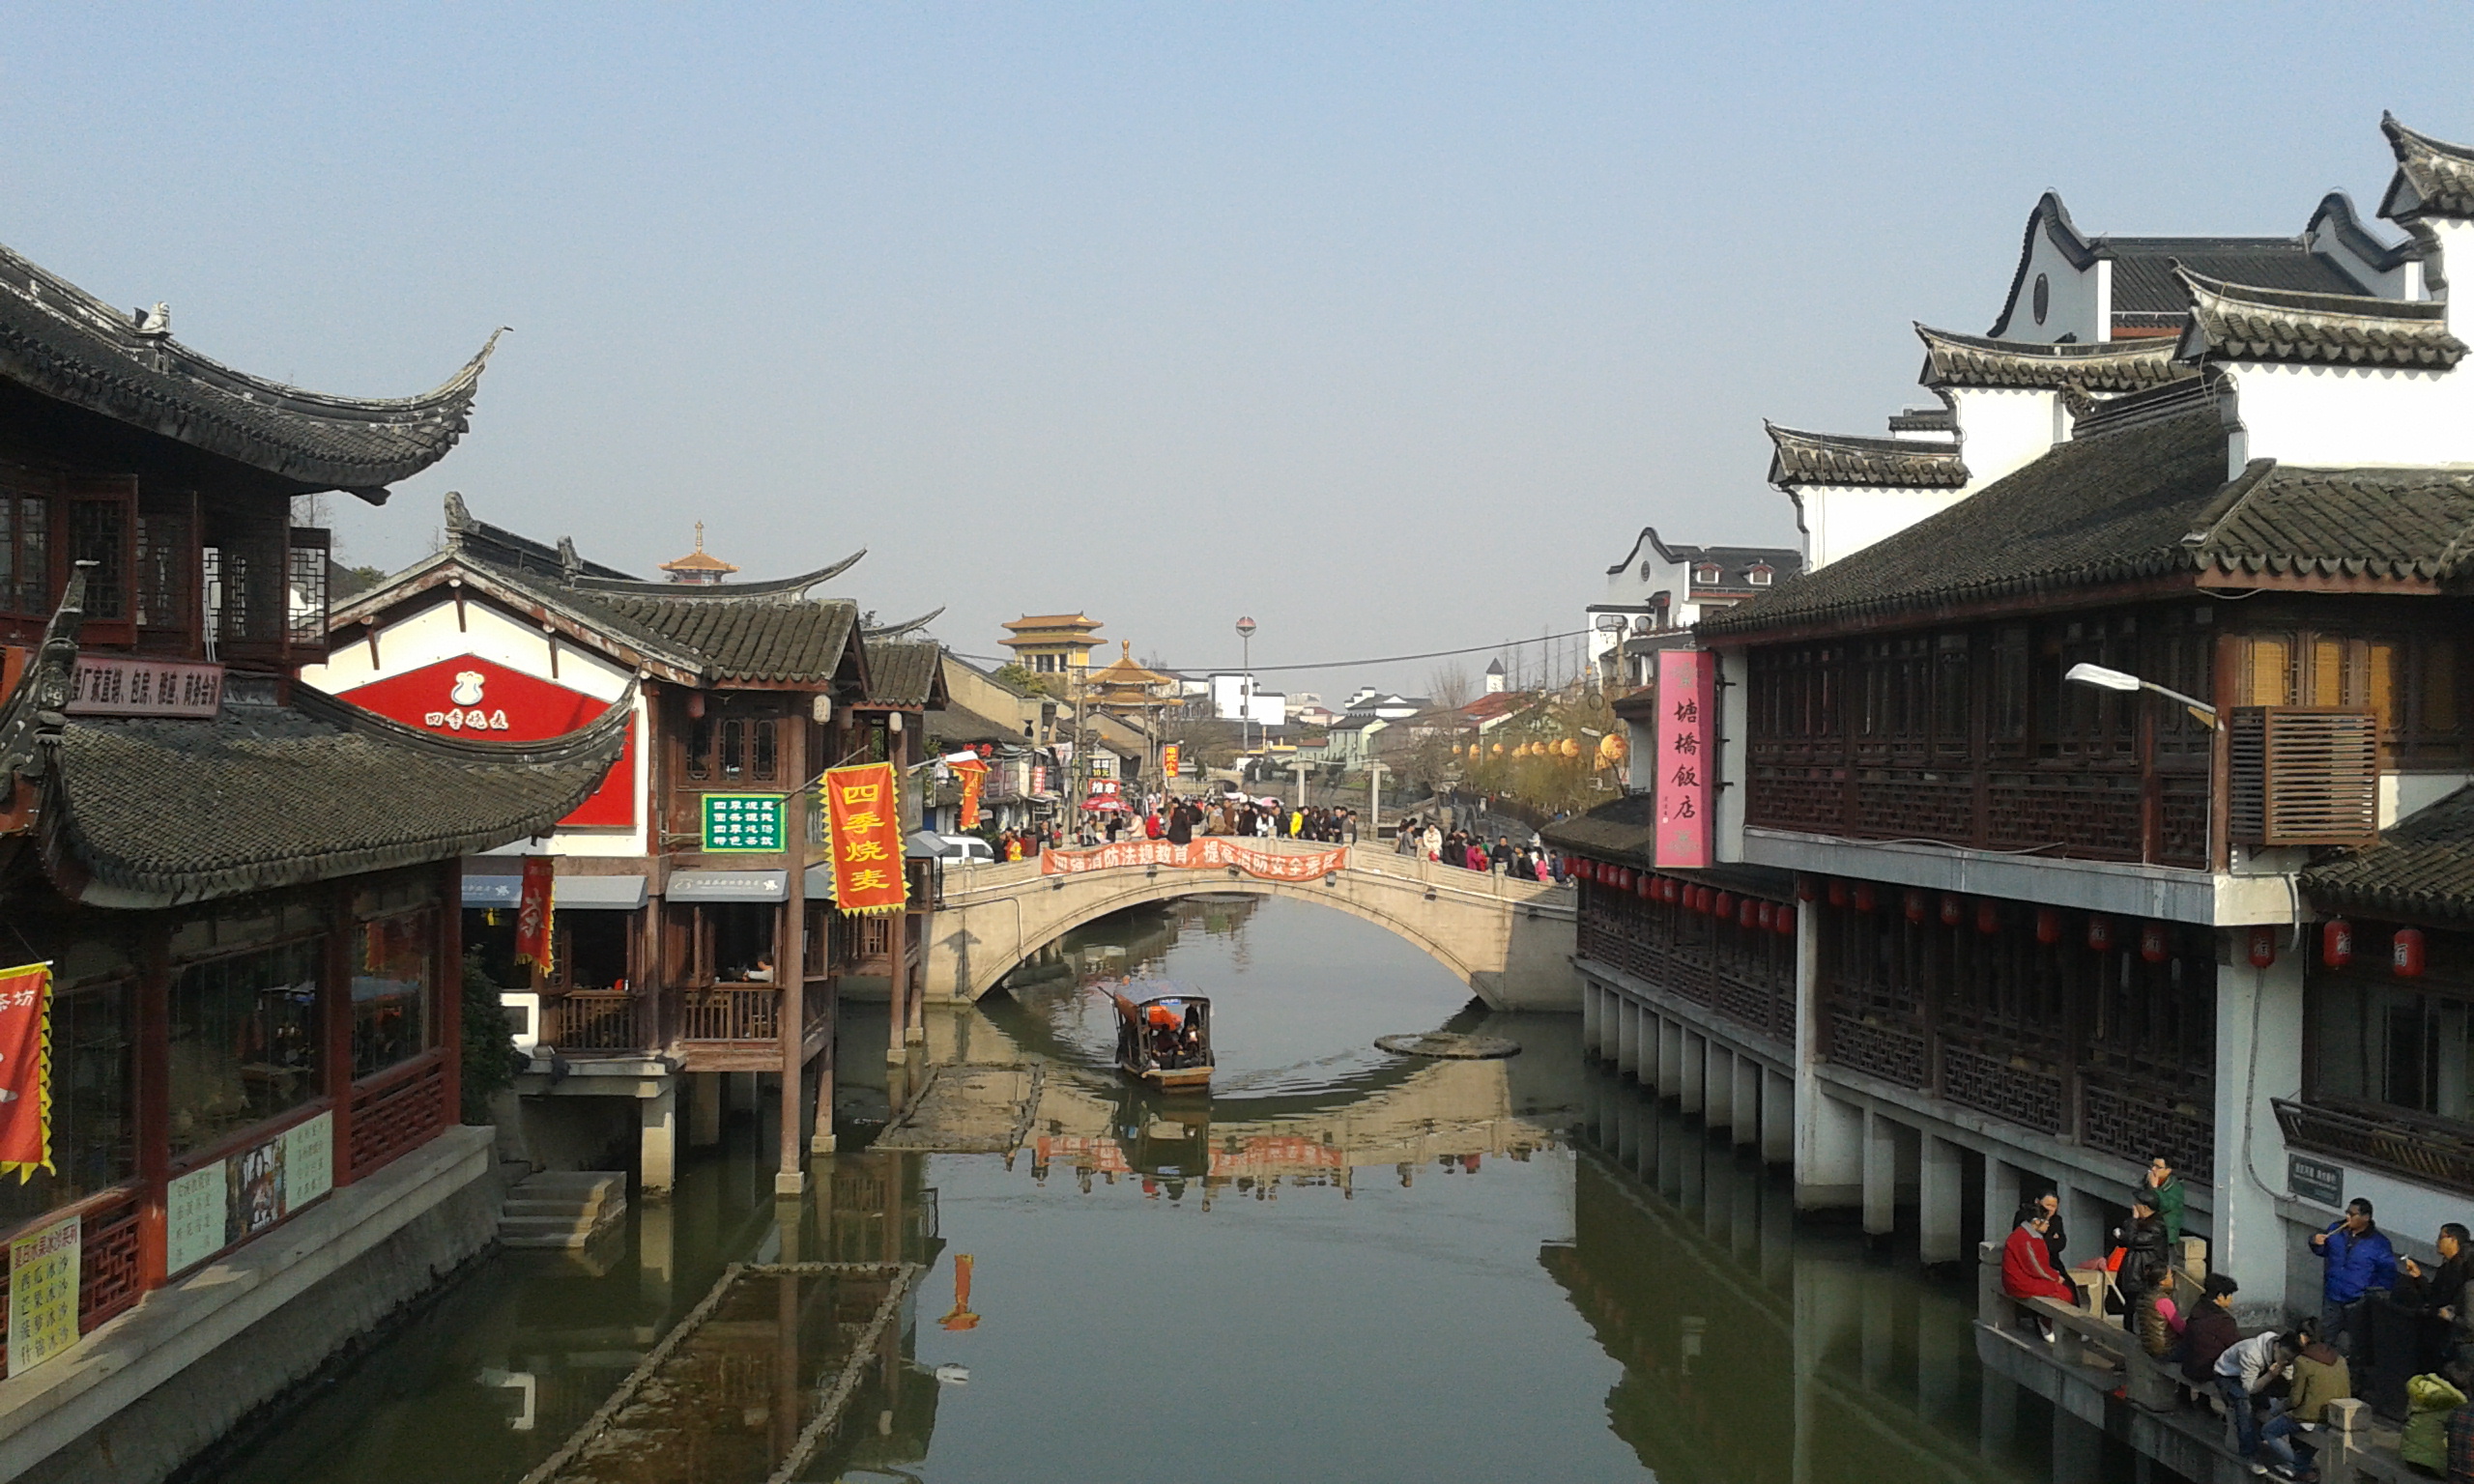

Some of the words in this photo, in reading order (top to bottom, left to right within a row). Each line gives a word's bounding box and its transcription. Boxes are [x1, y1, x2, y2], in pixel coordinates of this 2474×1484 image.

[425, 708, 509, 730] 四季烧麦
[1671, 698, 1701, 820] 塘橋飯店
[843, 784, 890, 892] 四季烧麦
